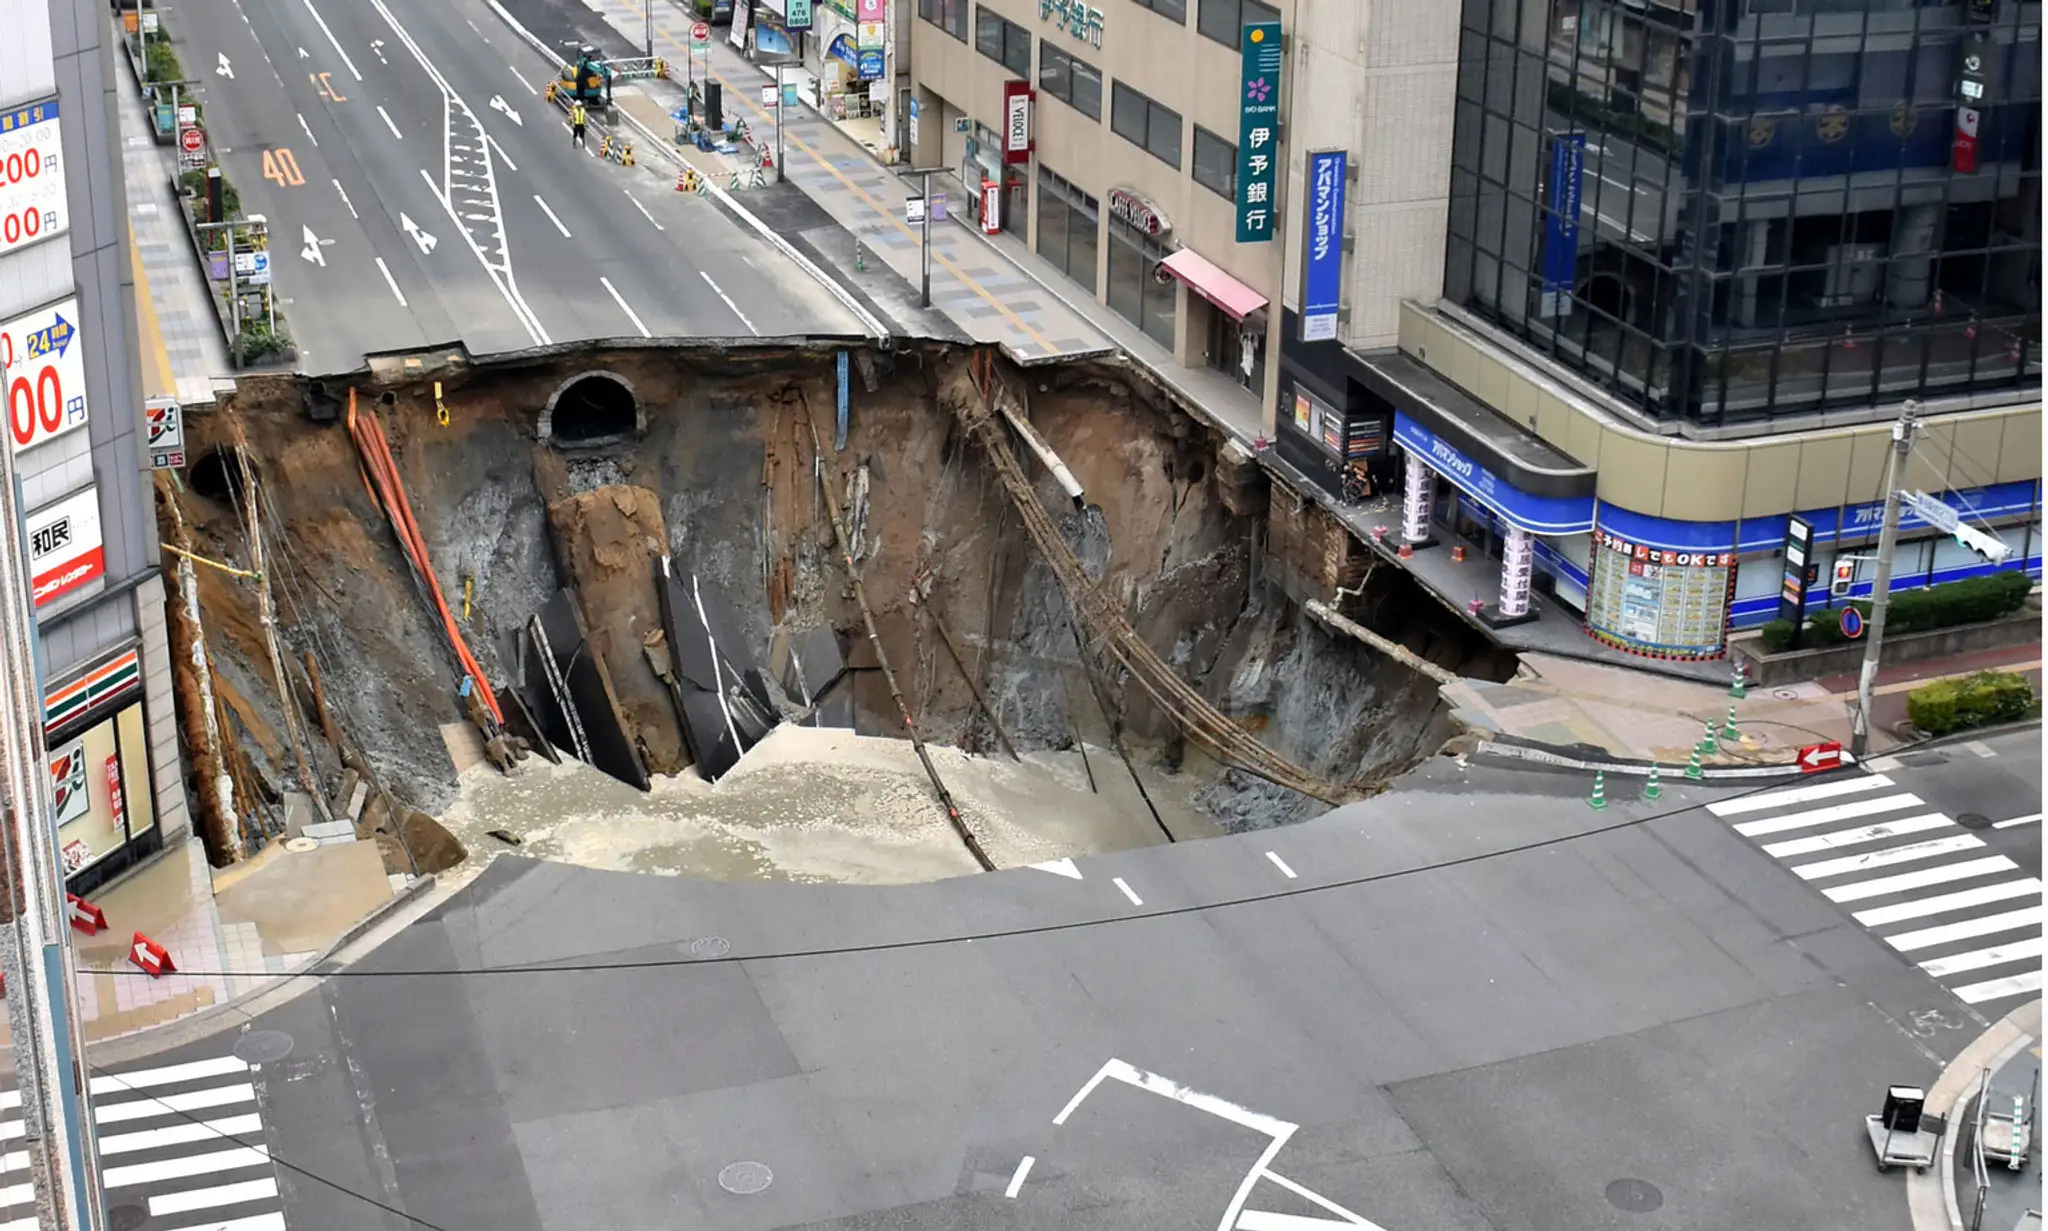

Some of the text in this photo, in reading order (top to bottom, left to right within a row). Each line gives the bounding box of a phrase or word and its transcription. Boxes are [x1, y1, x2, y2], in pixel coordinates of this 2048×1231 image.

[263, 147, 305, 187] 40
[1246, 127, 1271, 231] 伊予銀行
[1314, 158, 1332, 261] アパマンショップ
[32, 519, 70, 556] 和民
